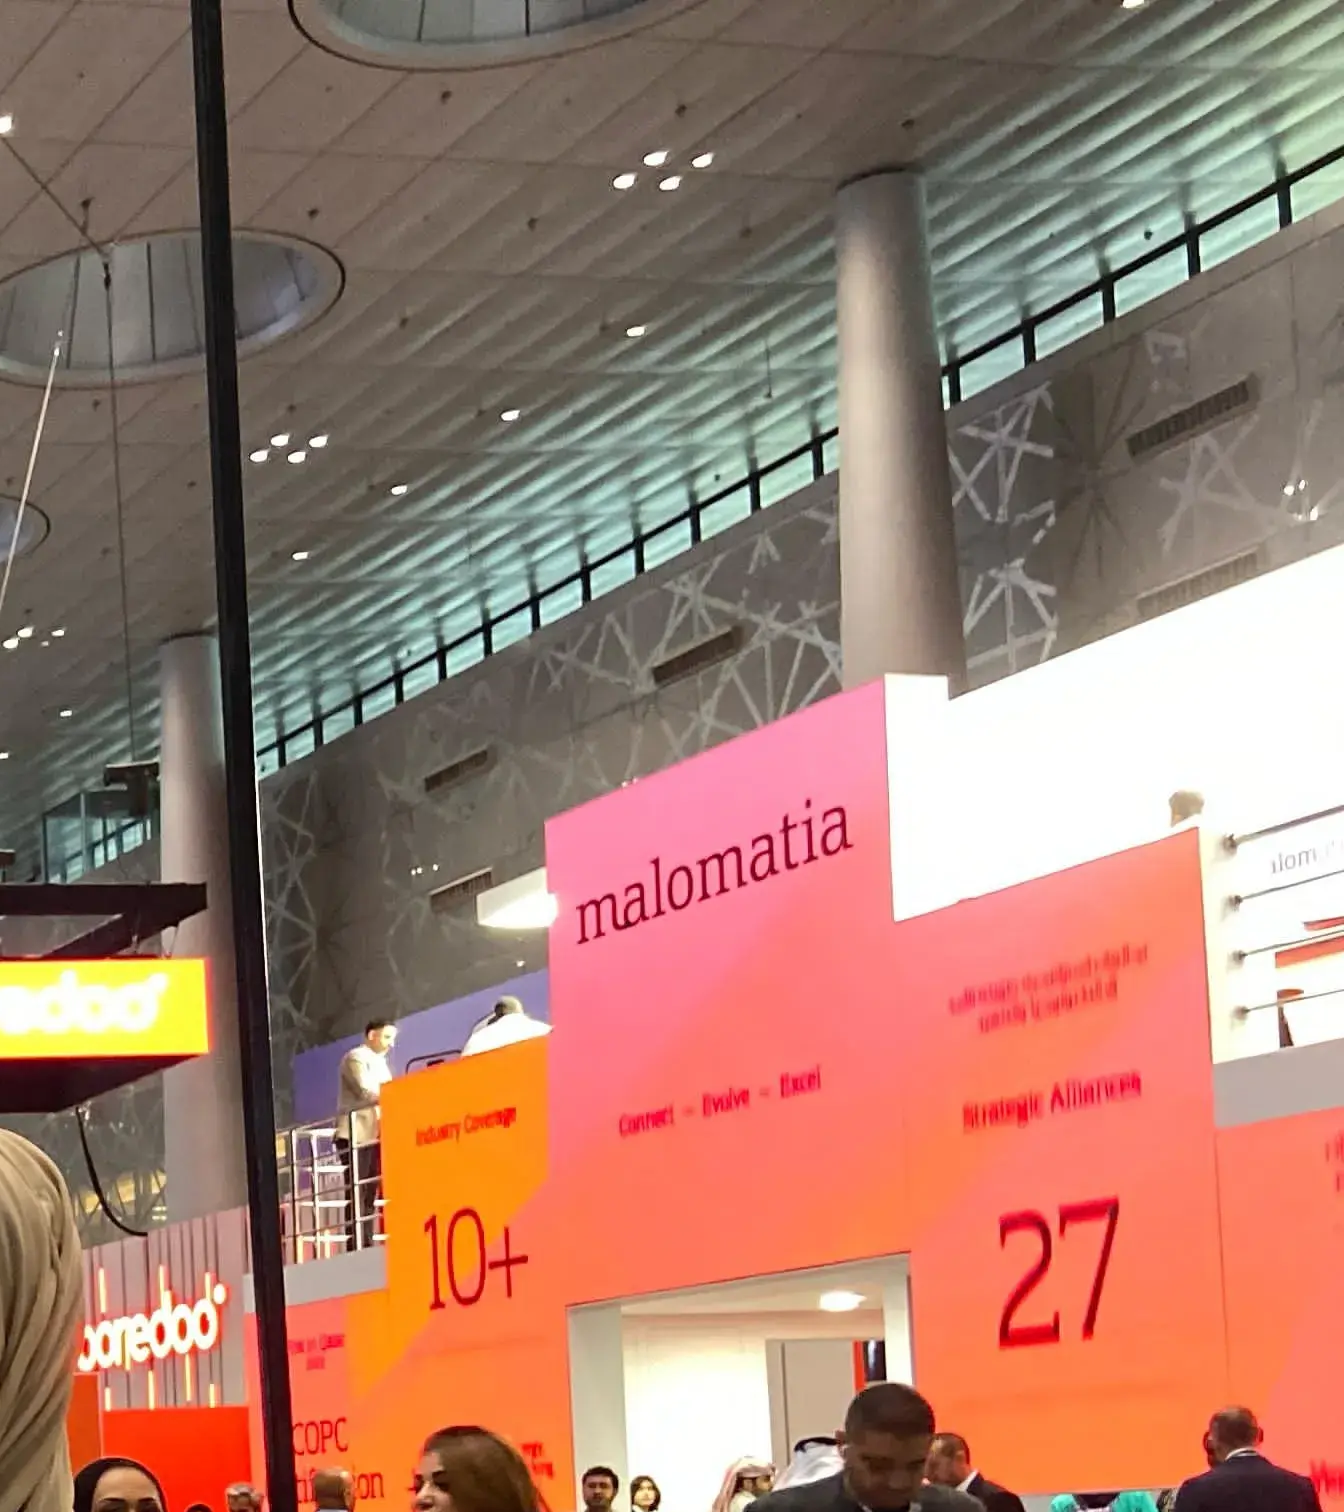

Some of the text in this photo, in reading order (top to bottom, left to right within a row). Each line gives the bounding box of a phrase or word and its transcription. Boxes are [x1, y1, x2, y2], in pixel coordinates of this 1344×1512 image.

[576, 798, 853, 945] malomatia
[779, 1064, 822, 1099] Excel
[424, 1208, 529, 1311] 10+
[998, 1197, 1120, 1350] 27
[293, 1417, 348, 1457] COPC
